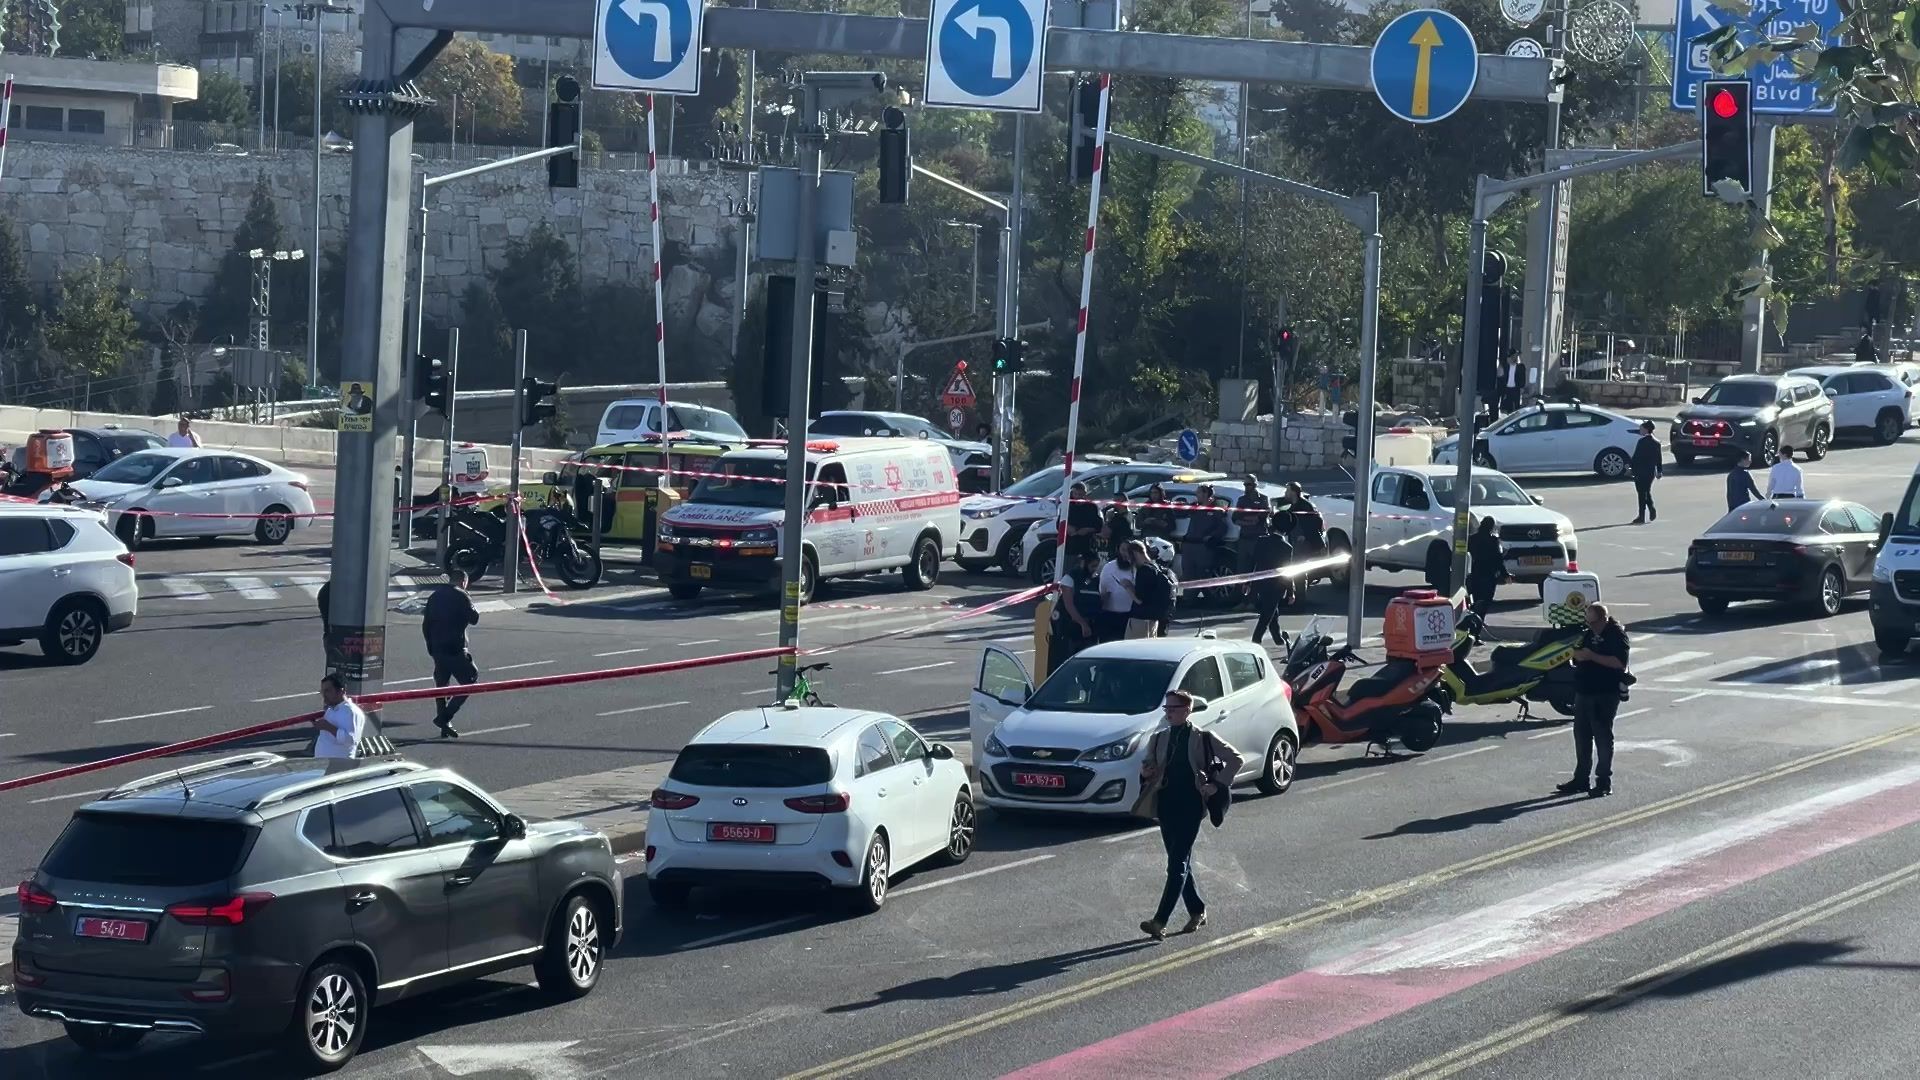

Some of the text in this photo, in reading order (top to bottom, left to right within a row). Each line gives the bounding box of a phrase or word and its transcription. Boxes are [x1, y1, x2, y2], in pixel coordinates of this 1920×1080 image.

[1699, 49, 1709, 63] 5
[1756, 85, 1800, 100] Blvd
[679, 512, 749, 523] AMBULANCE
